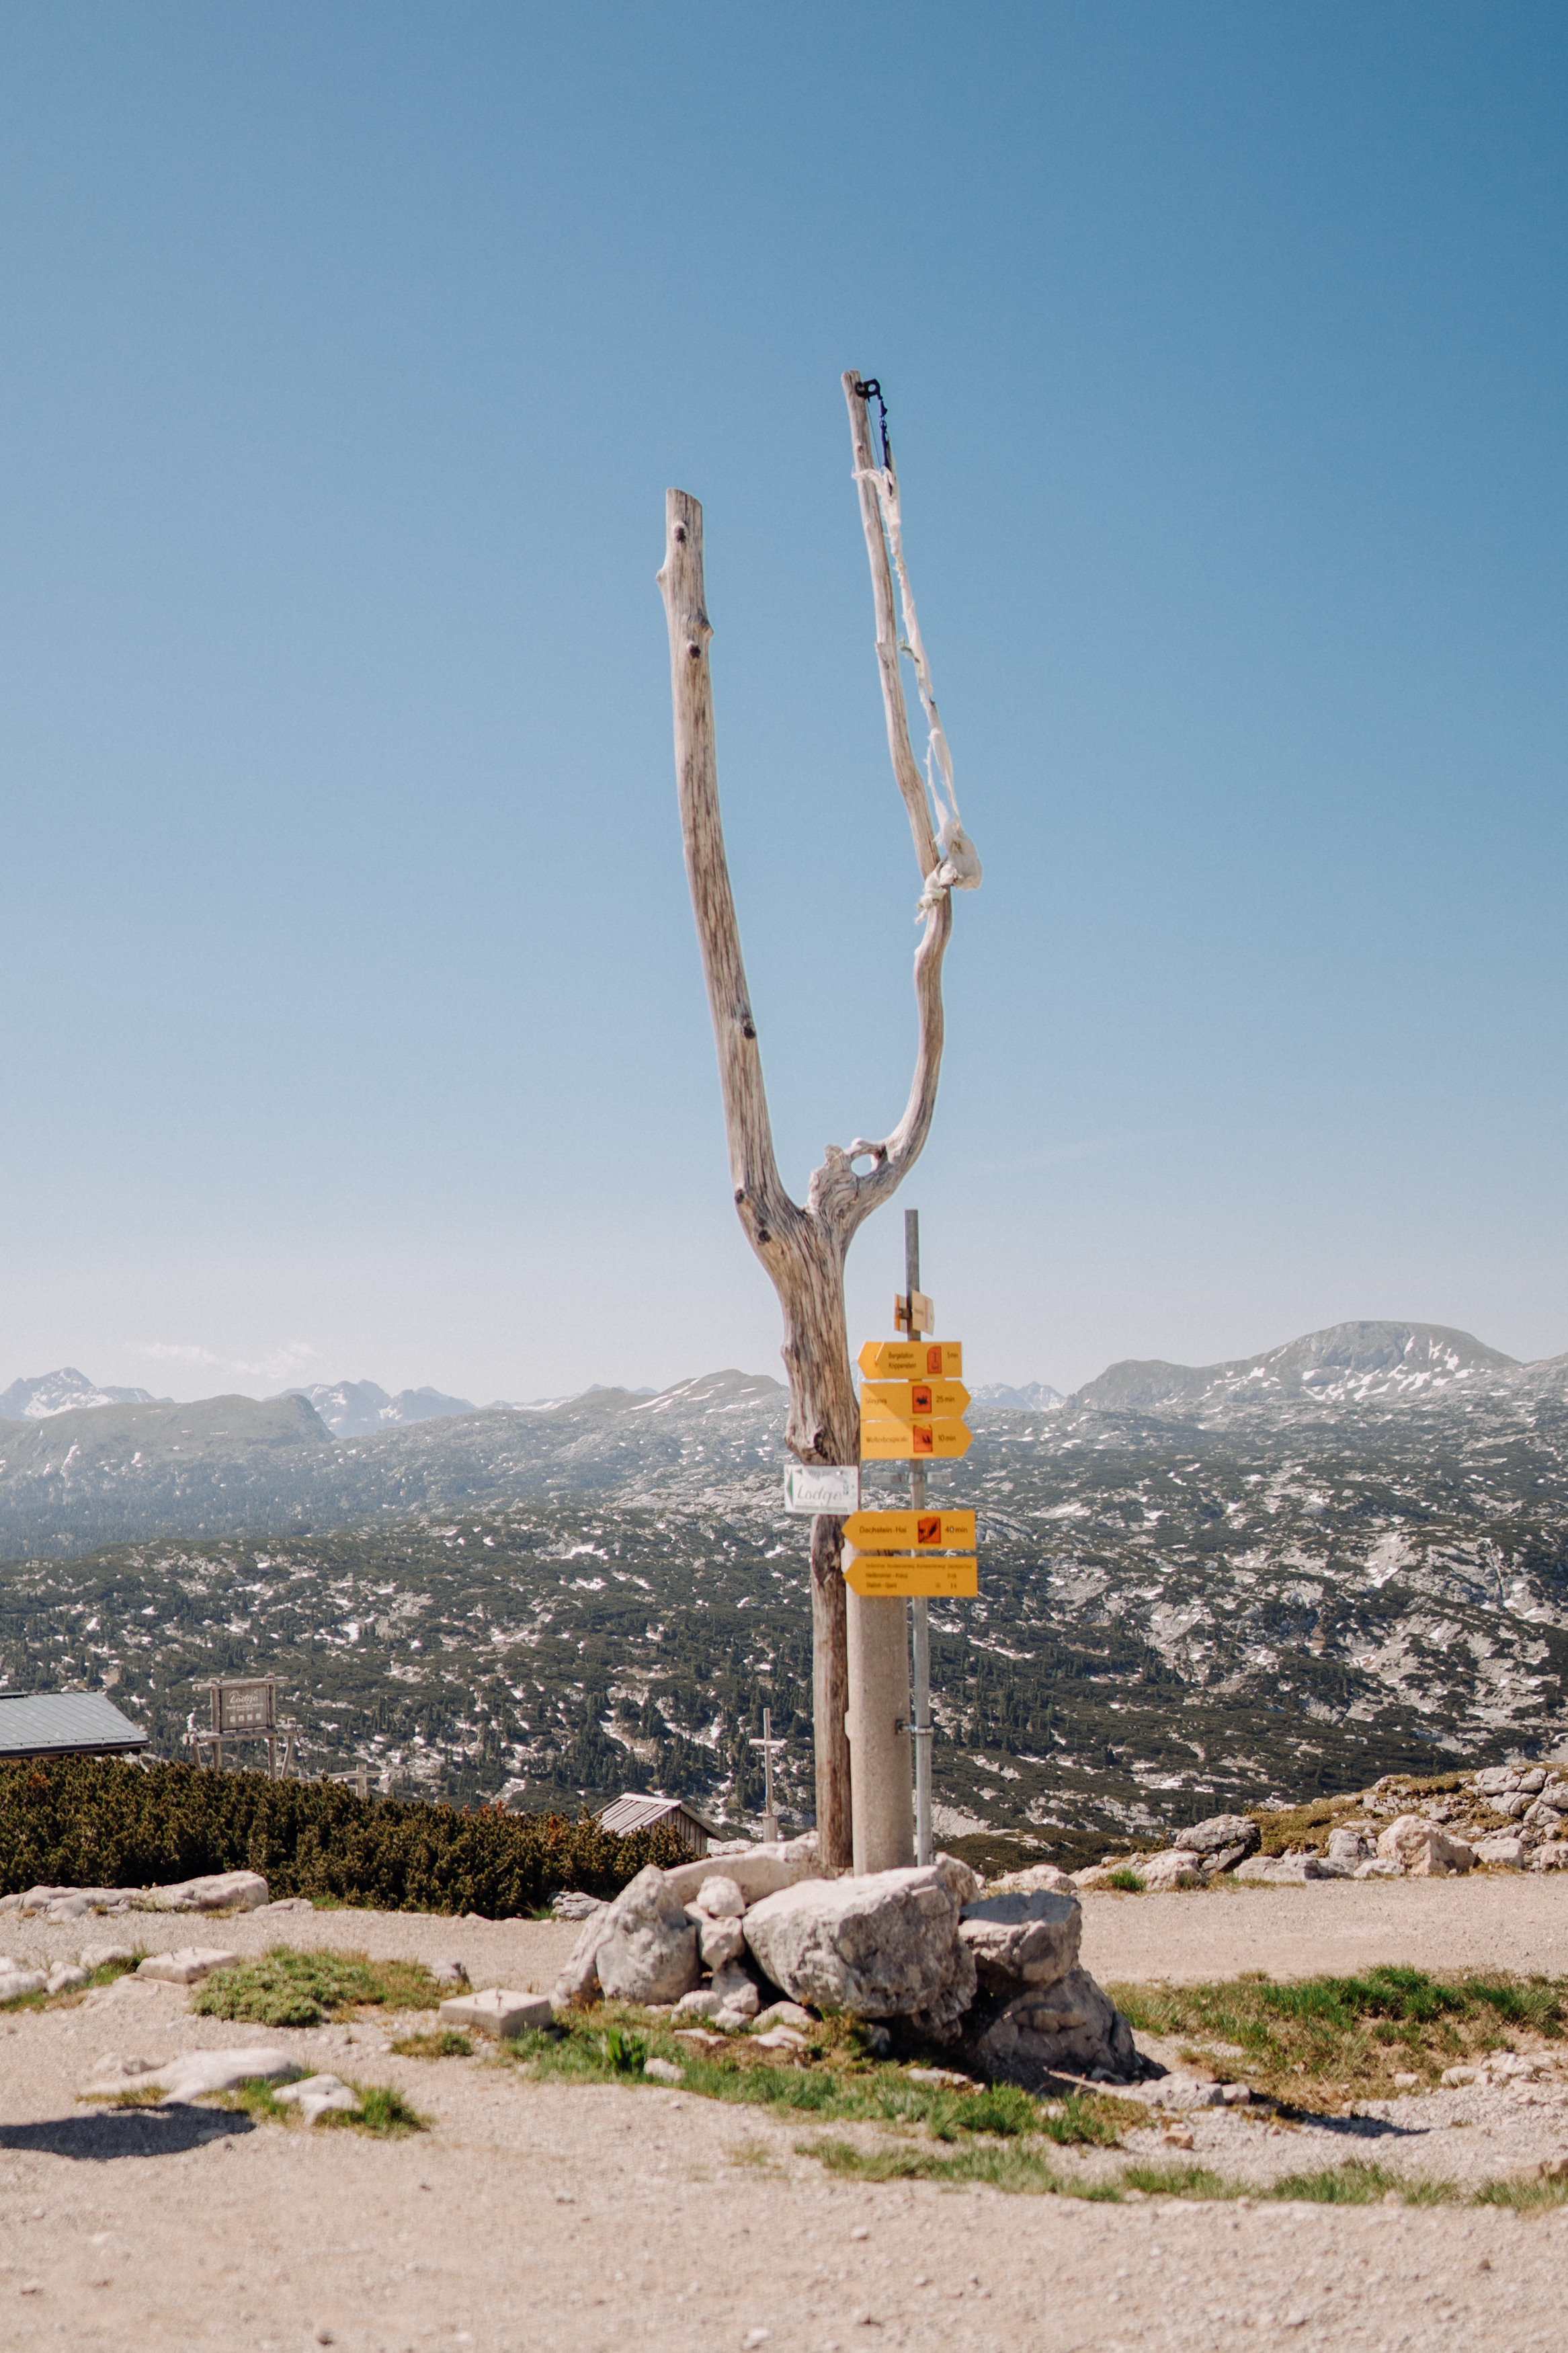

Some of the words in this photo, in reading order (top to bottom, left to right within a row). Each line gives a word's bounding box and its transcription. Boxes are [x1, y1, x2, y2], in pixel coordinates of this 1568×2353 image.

[944, 1395, 955, 1403] min
[938, 1434, 945, 1442] 10
[798, 1484, 841, 1506] Lodge
[860, 1525, 893, 1534] Dachstein
[230, 1694, 259, 1704] Lodge
